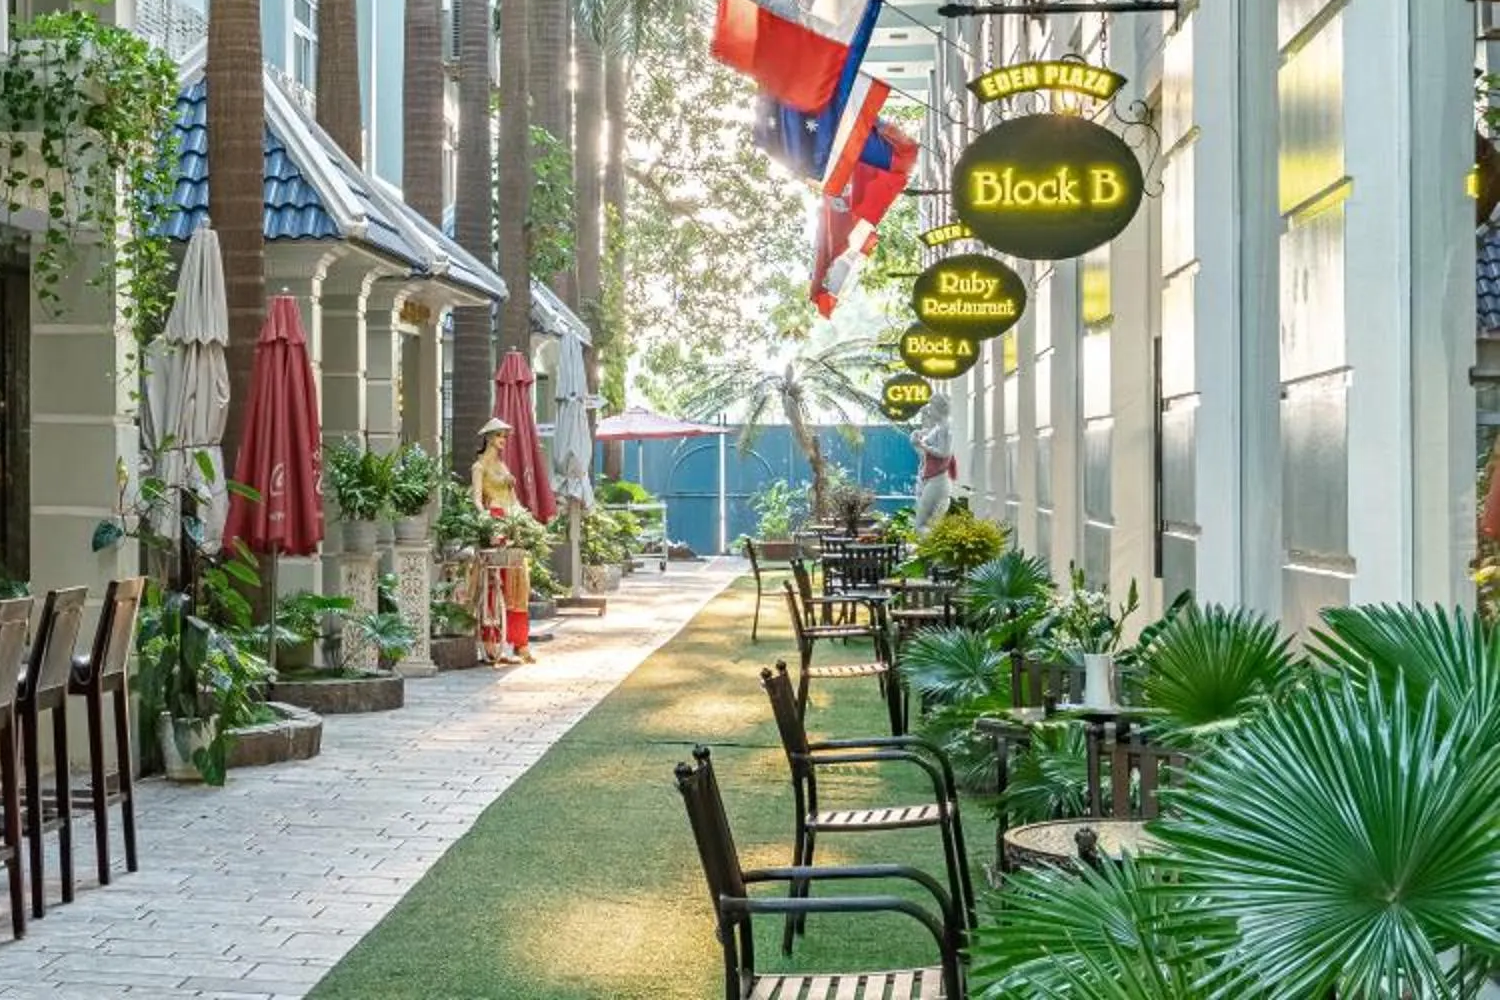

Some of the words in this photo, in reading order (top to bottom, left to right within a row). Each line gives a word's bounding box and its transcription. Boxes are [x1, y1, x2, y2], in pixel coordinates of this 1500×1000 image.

[981, 65, 1039, 98] EDEN
[1043, 64, 1112, 95] PLAZA
[971, 165, 1079, 206] Block
[1091, 169, 1122, 201] B
[939, 271, 999, 299] Ruby
[921, 297, 1016, 316] Restaurant
[906, 337, 953, 355] Block
[957, 340, 972, 356] A
